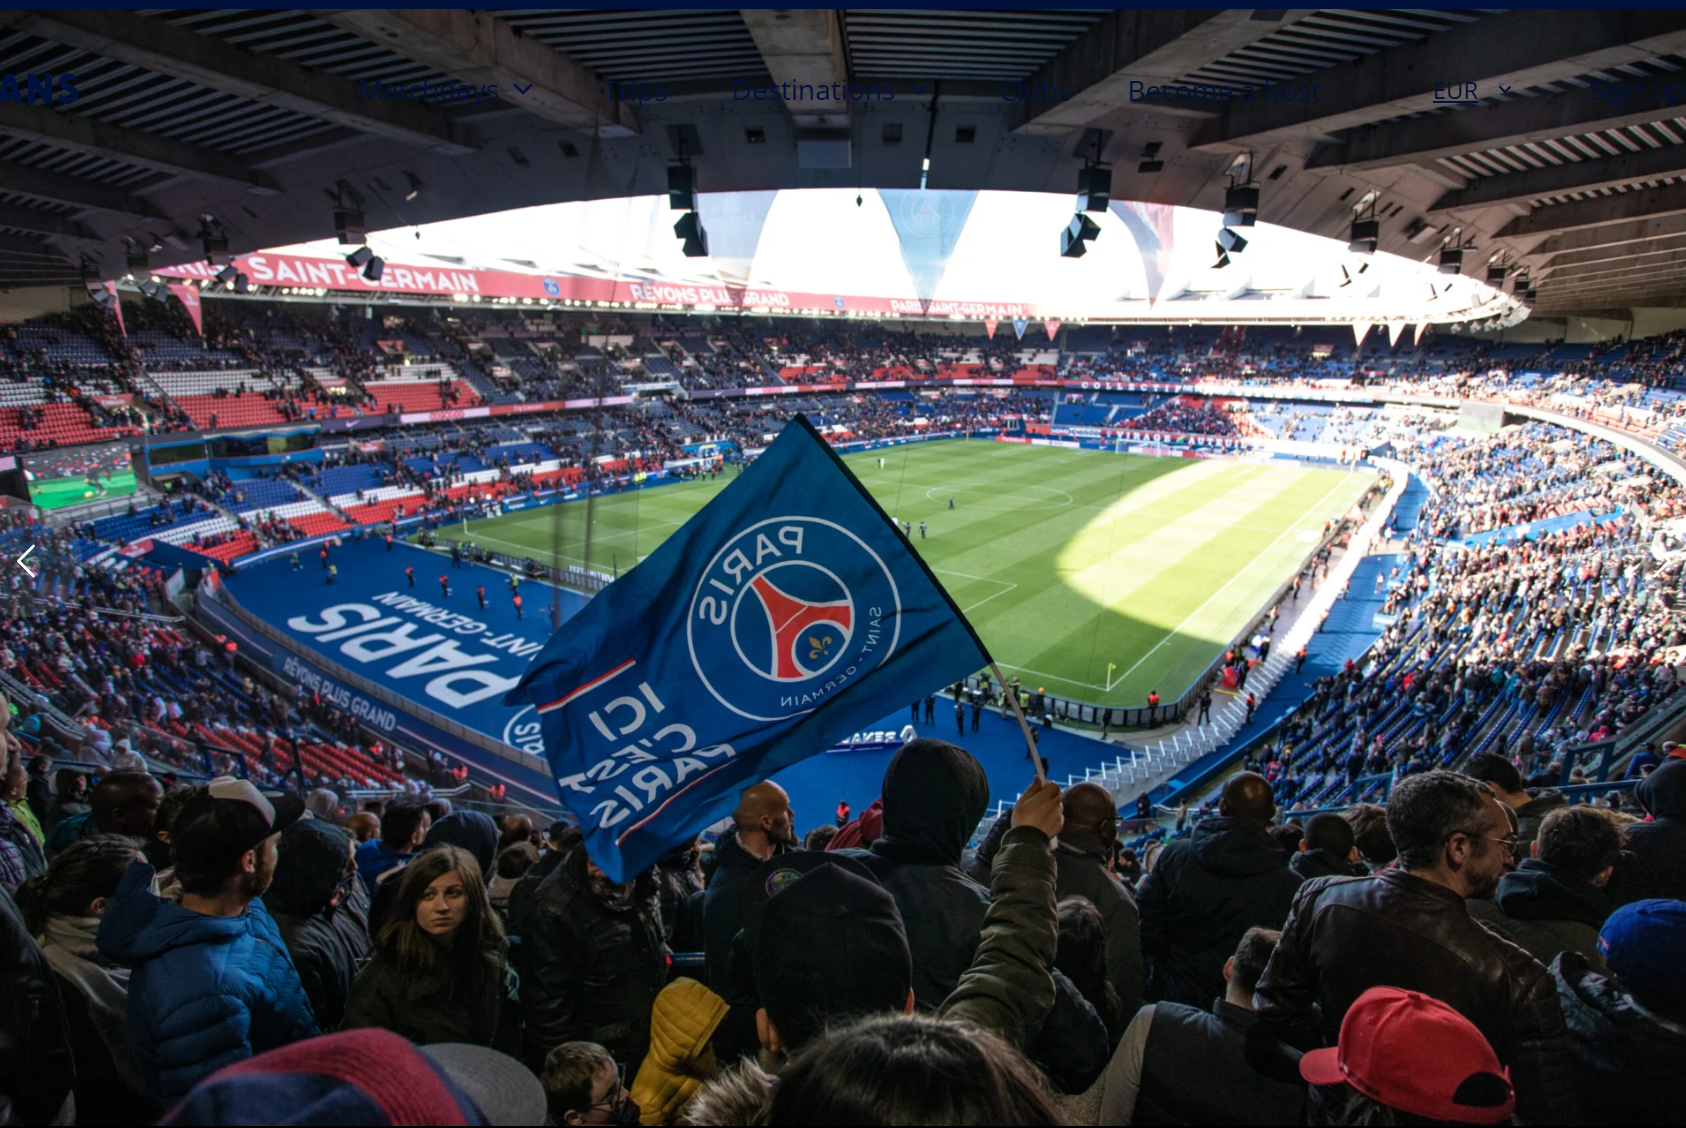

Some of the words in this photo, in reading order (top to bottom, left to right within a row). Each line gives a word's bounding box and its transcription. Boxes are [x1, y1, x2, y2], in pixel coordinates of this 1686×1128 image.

[700, 289, 738, 305] PLUS
[740, 290, 790, 307] GRAND
[890, 300, 925, 312] PARIS
[928, 302, 1023, 315] SAINT-GERMAIN
[1082, 381, 1182, 393] COLLECTIF
[1117, 432, 1171, 443] VIRAGE
[1189, 436, 1247, 448] AUTEUIL
[287, 603, 523, 709] PARIS
[321, 679, 351, 708] PLUS
[351, 696, 396, 731] GRAND
